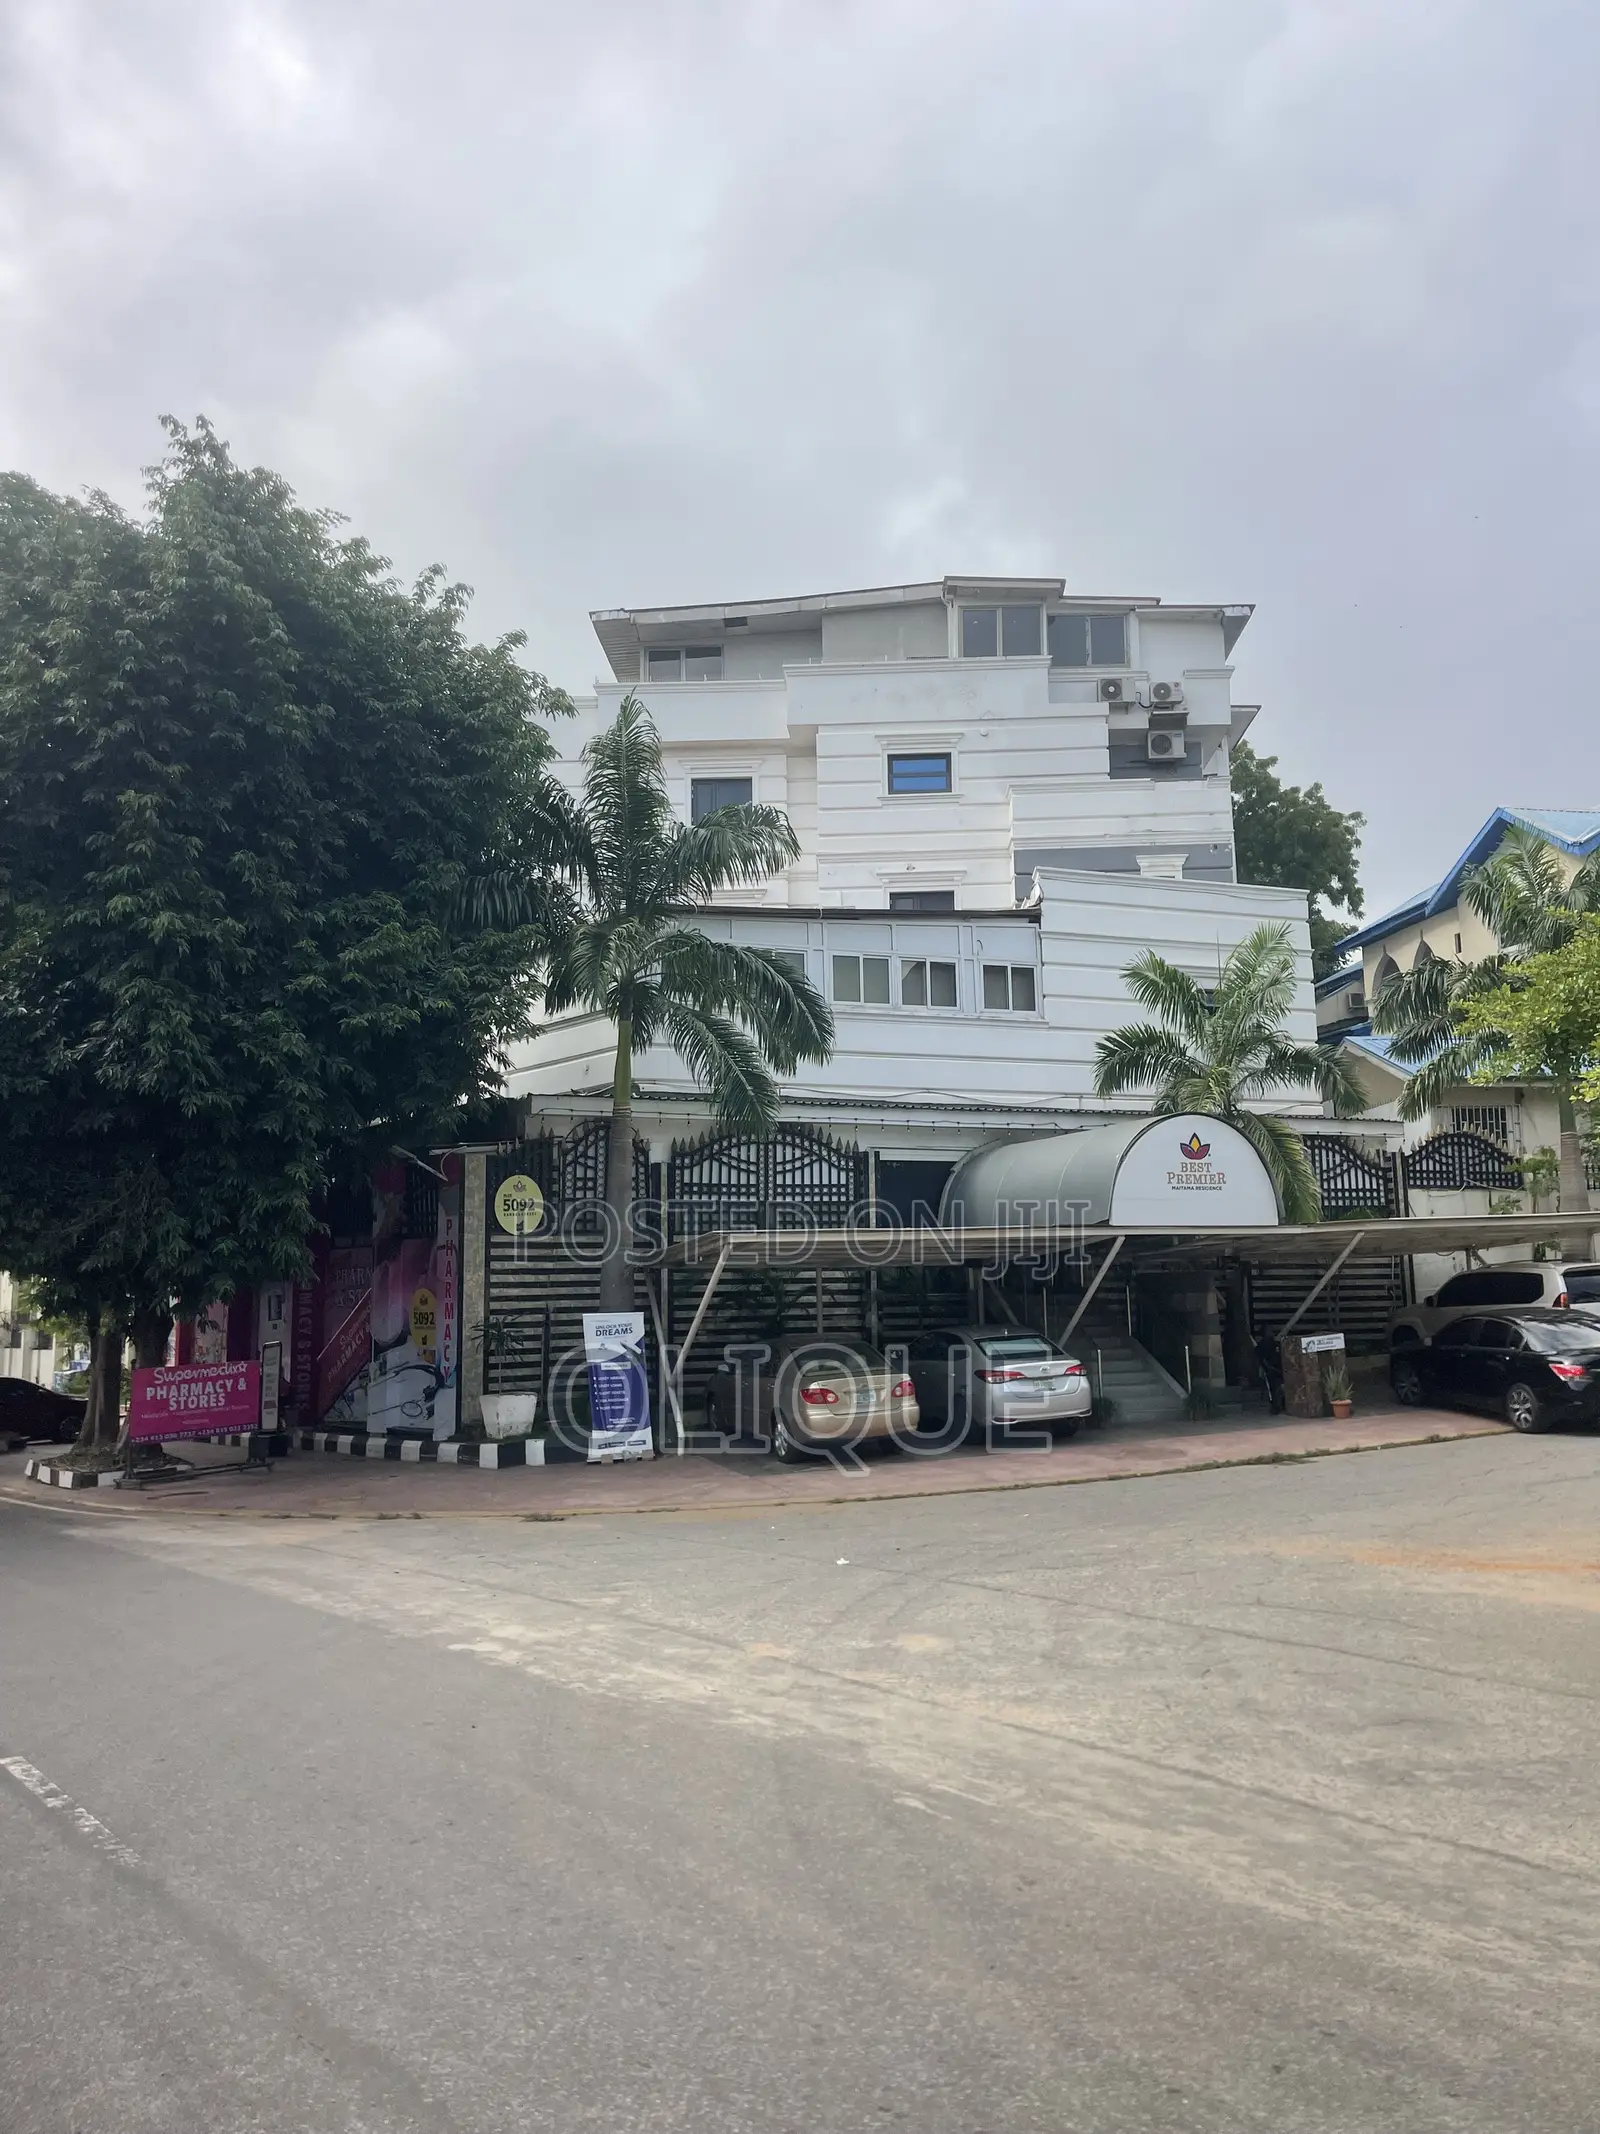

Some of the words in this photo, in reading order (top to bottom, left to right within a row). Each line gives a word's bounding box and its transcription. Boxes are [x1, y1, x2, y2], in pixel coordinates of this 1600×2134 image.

[1180, 1162, 1212, 1173] BEST
[1167, 1172, 1226, 1184] PREMIER
[503, 1198, 535, 1212] 5092
[444, 1218, 454, 1383] PHARMACY
[413, 1311, 436, 1325] 5092
[595, 1327, 633, 1337] DREAMS
[146, 1379, 234, 1401] PHARMACY
[237, 1378, 247, 1391] &
[169, 1393, 226, 1411] STORES
